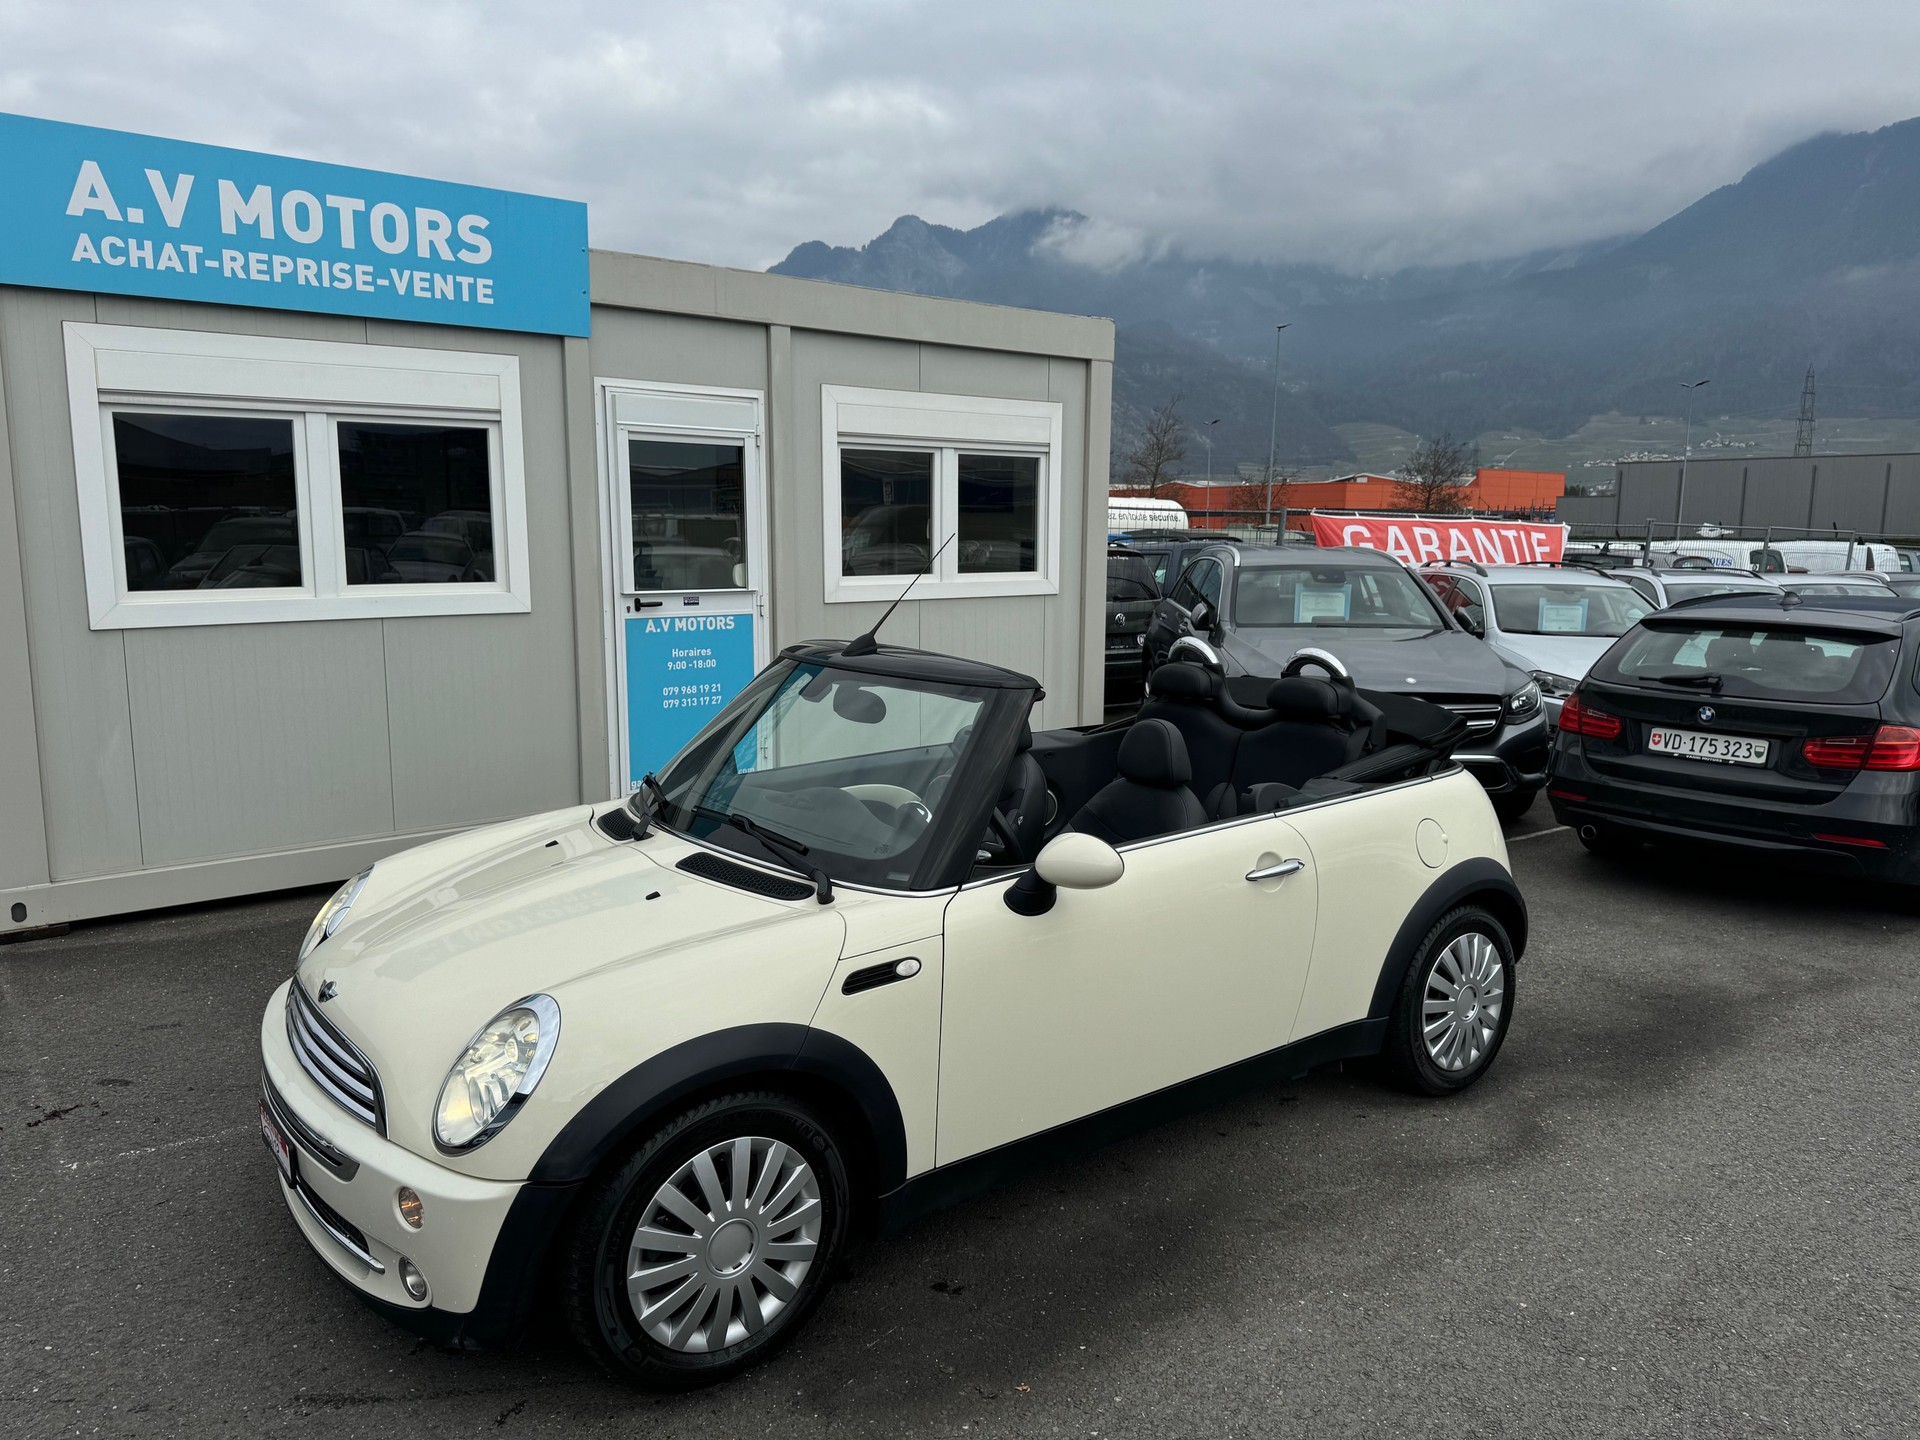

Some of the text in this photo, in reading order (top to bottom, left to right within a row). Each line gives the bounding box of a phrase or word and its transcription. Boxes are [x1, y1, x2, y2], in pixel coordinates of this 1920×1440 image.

[65, 159, 493, 266] A.V MOTORS
[71, 233, 494, 304] ACHAT-REPRISE-VENTE
[1128, 512, 1148, 521] toute
[645, 616, 735, 633] A.V MOTORS
[672, 648, 712, 658] Horaires
[667, 661, 687, 671] 9:00
[662, 683, 721, 696] 079 968 19 21
[663, 695, 722, 709] 079 313 17 27
